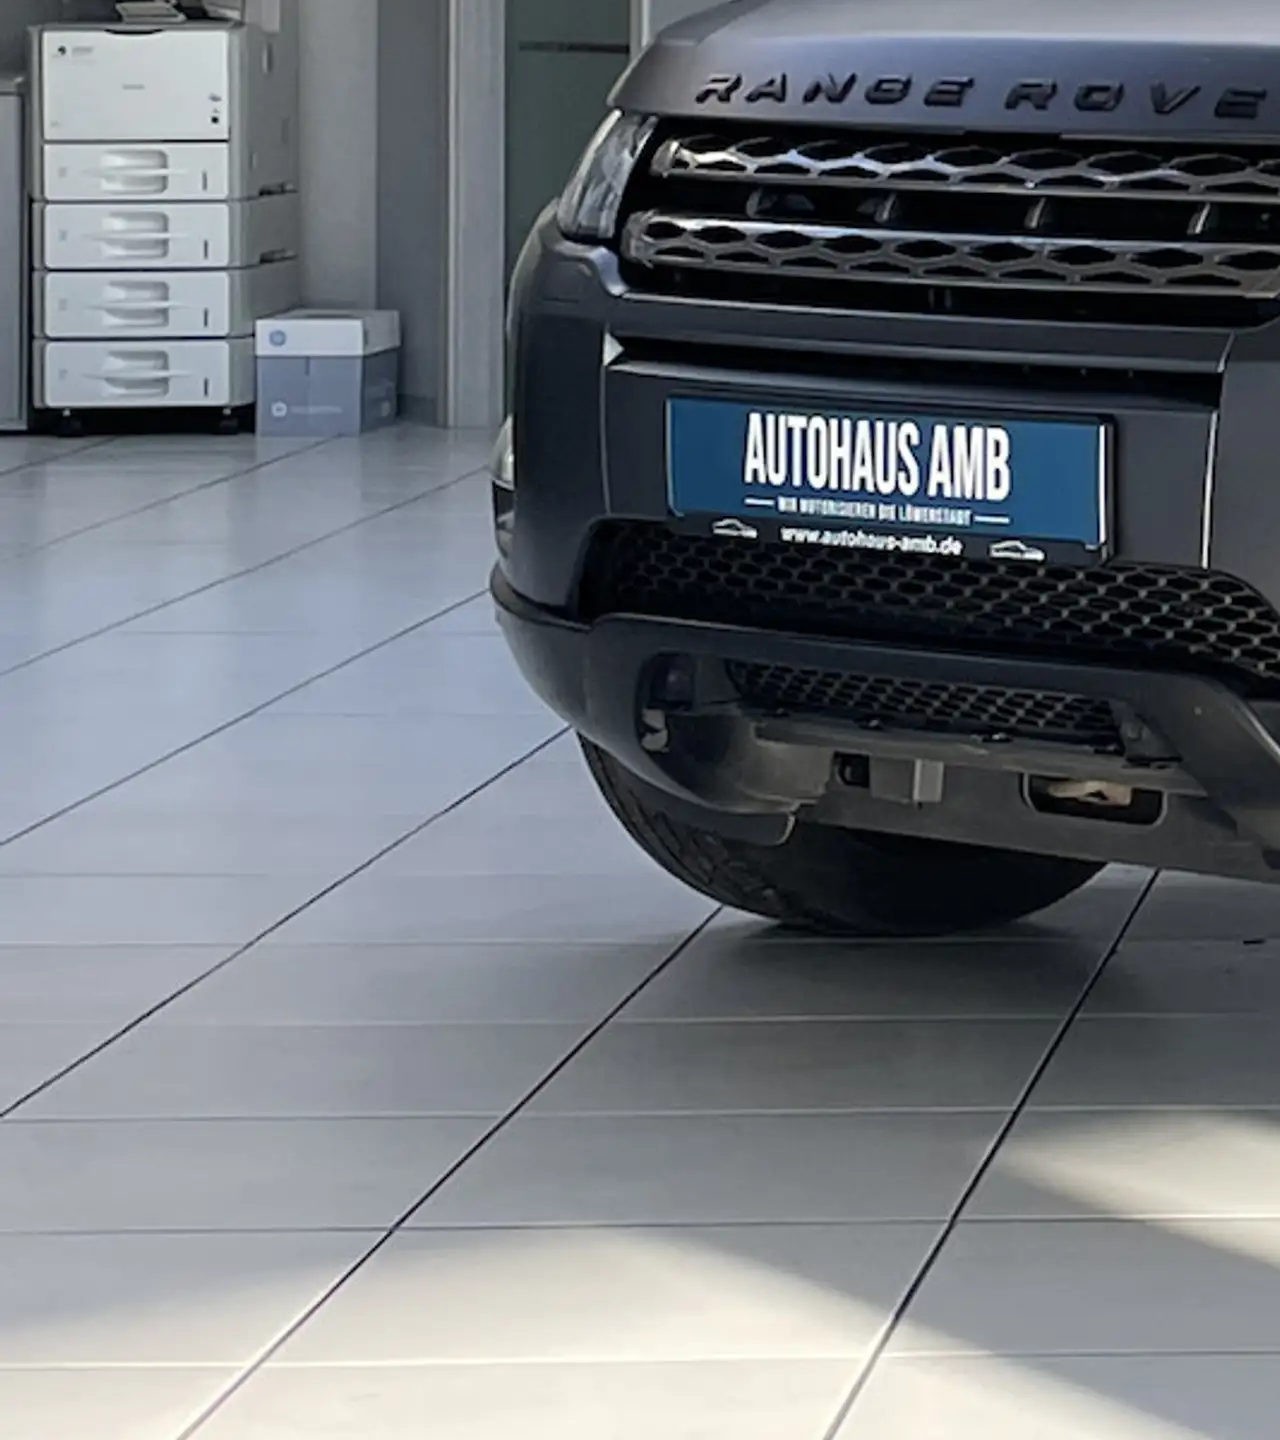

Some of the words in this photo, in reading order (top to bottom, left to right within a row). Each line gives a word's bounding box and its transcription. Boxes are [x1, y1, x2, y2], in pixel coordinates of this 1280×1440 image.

[695, 72, 974, 109] RANGE
[744, 412, 920, 497] AUTOHAUS
[927, 424, 1011, 501] AMB
[780, 526, 964, 556] www.autohaus-amb.de
